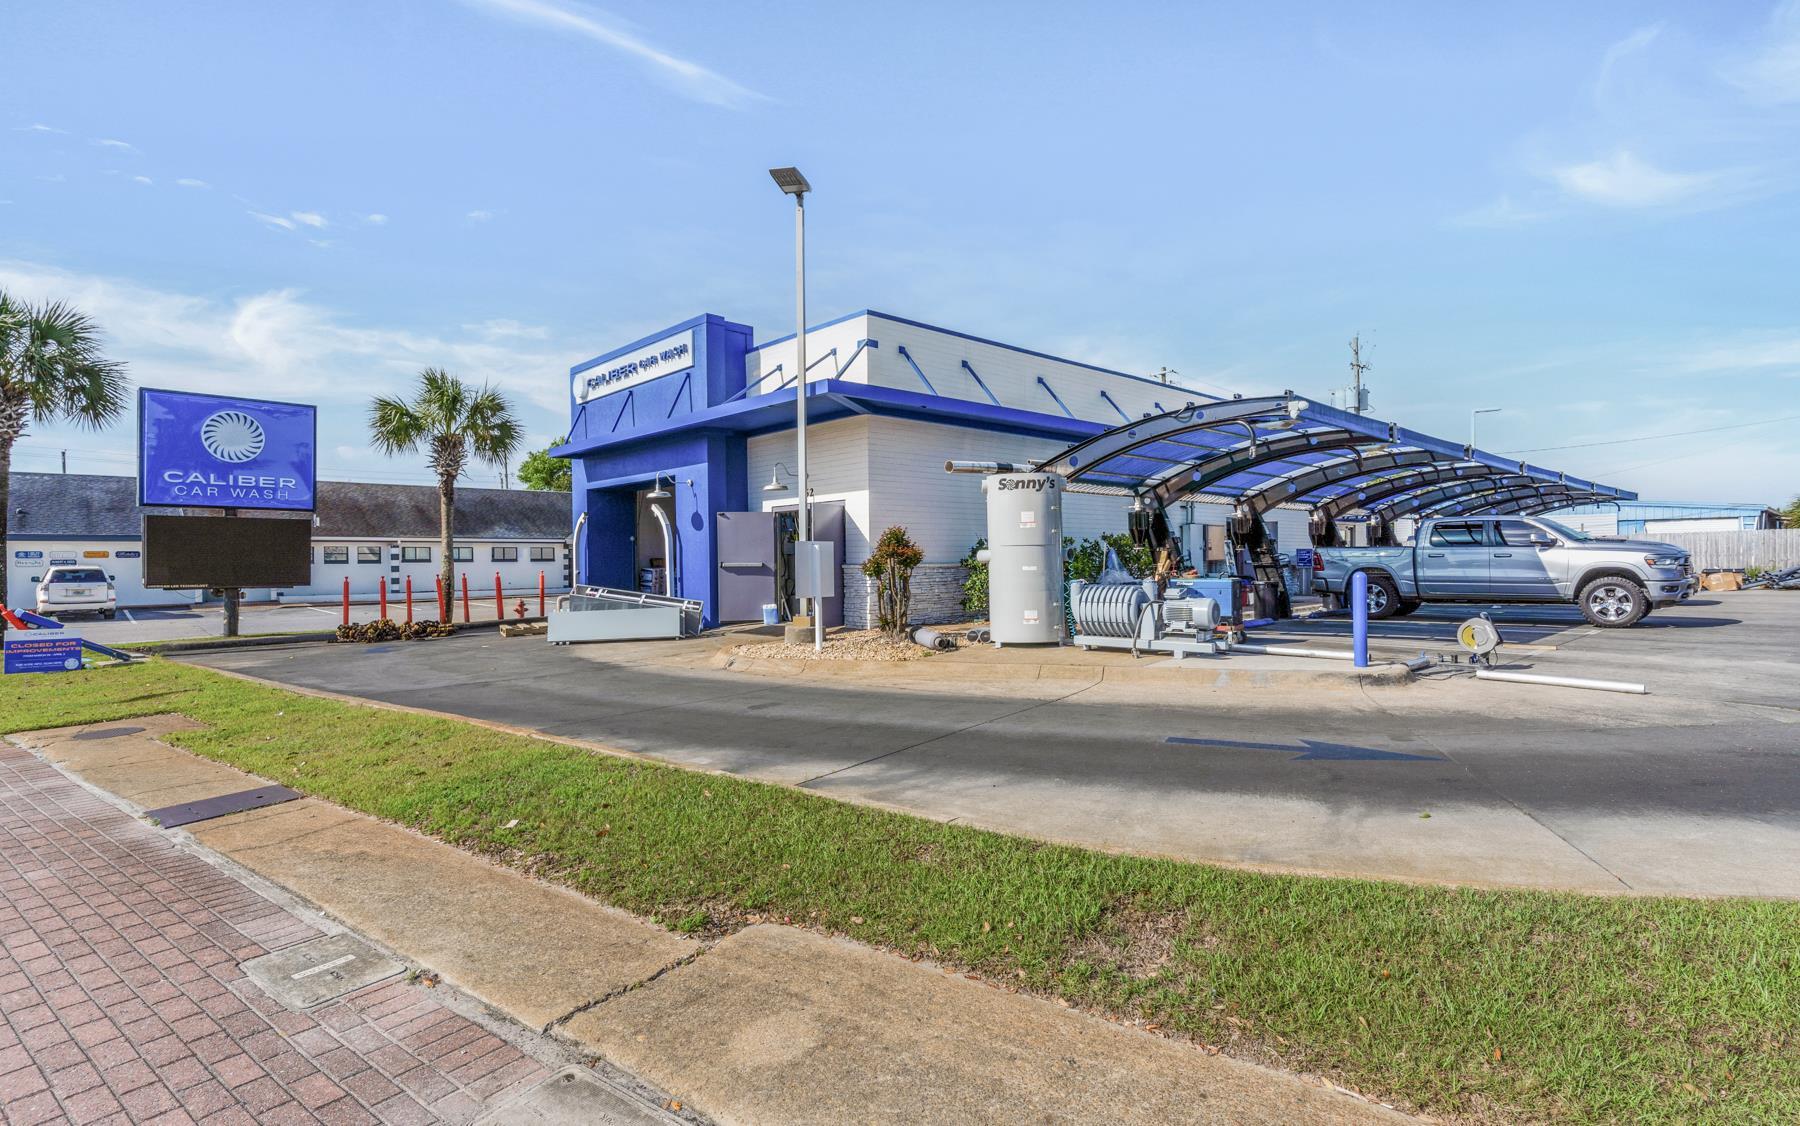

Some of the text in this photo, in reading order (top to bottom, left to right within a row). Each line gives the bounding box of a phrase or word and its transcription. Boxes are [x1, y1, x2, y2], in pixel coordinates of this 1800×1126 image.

[587, 343, 689, 388] CALIBER CAR WASH
[163, 470, 297, 489] CALIBER
[997, 476, 1056, 492] Sonny's
[174, 485, 289, 500] CAR WASH
[5, 646, 81, 654] IMPROVEMENTS
